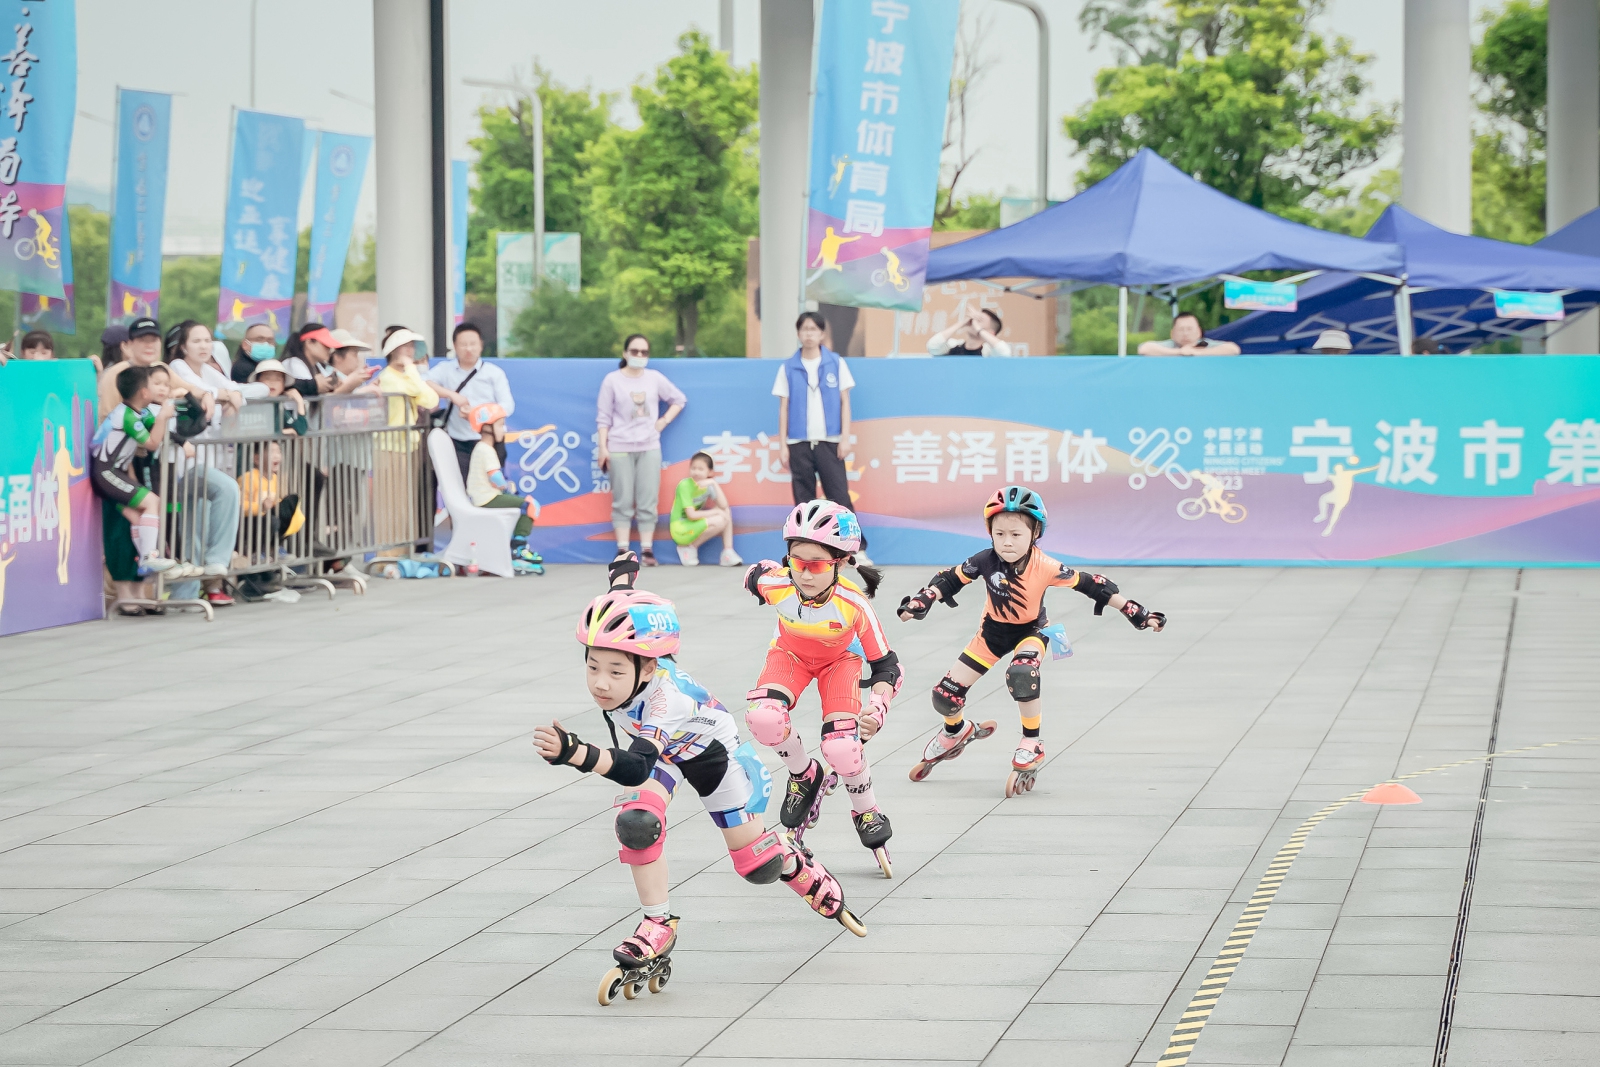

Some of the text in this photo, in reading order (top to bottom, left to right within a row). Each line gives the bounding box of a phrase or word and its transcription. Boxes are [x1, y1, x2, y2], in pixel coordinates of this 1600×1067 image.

[842, 0, 910, 237] 宁波市体育局
[1289, 418, 1600, 487] 宁波市第
[647, 613, 673, 631] 901
